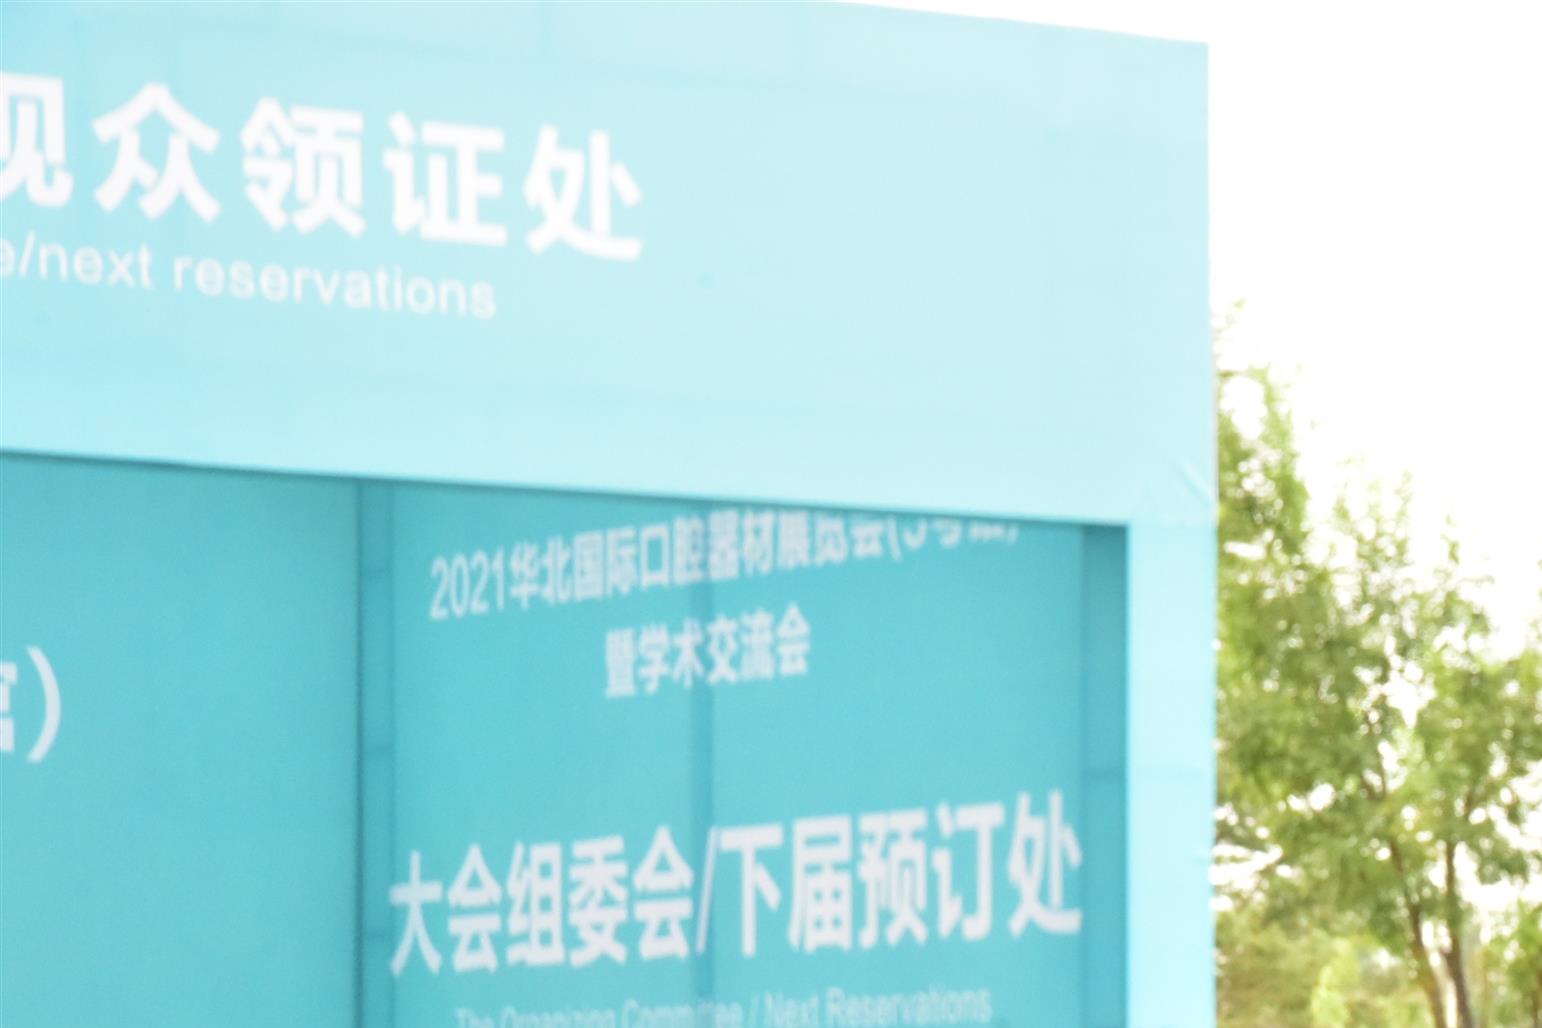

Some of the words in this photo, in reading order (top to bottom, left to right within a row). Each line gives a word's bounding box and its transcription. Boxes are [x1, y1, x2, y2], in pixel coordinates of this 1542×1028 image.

[174, 252, 497, 319] reservations
[605, 602, 811, 699] 暨学术交流会
